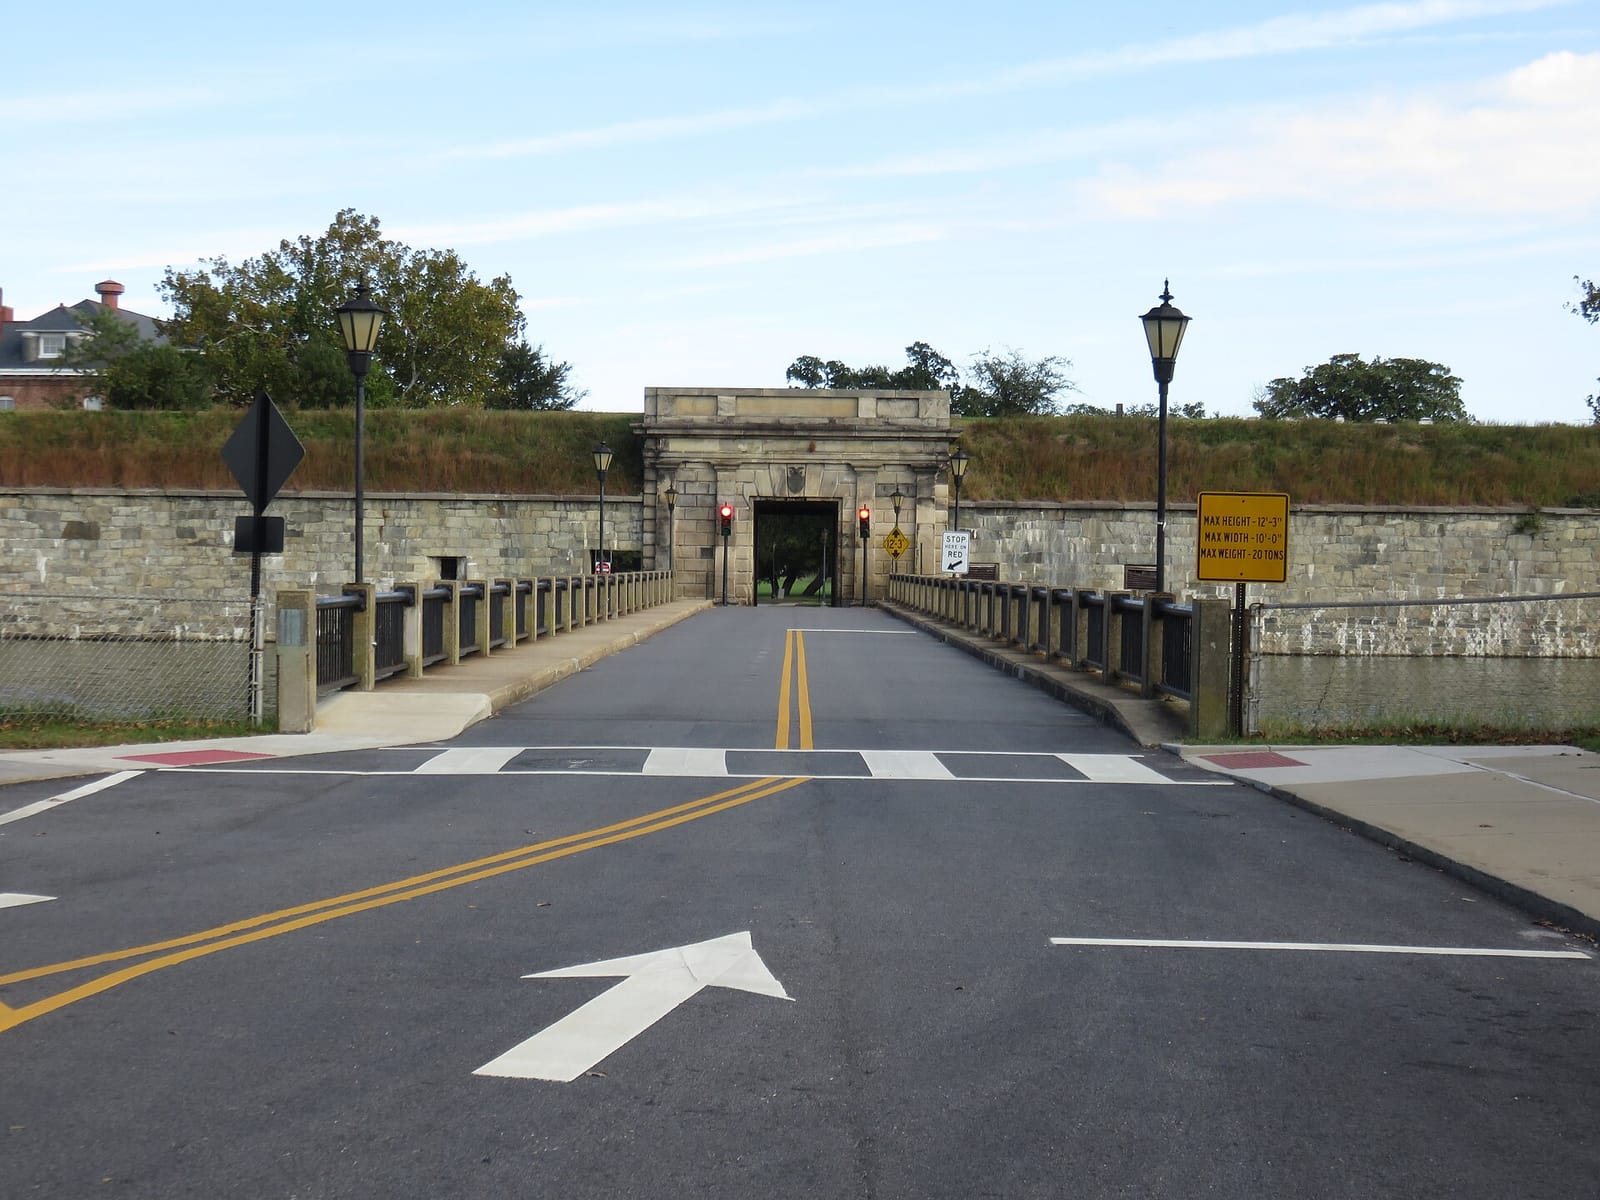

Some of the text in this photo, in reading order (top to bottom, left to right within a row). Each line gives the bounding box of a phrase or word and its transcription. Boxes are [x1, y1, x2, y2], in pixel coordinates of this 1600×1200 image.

[1203, 515, 1220, 526] MAX
[1222, 516, 1251, 527] HEIGHT
[946, 535, 966, 543] STOP
[1204, 532, 1221, 543] MAX
[1223, 532, 1249, 543] WIDTH
[947, 550, 963, 559] RED
[1200, 548, 1217, 559] MAX
[1218, 548, 1246, 559] WEIGHT
[1252, 549, 1263, 560] 20
[1264, 550, 1284, 561] TONS
